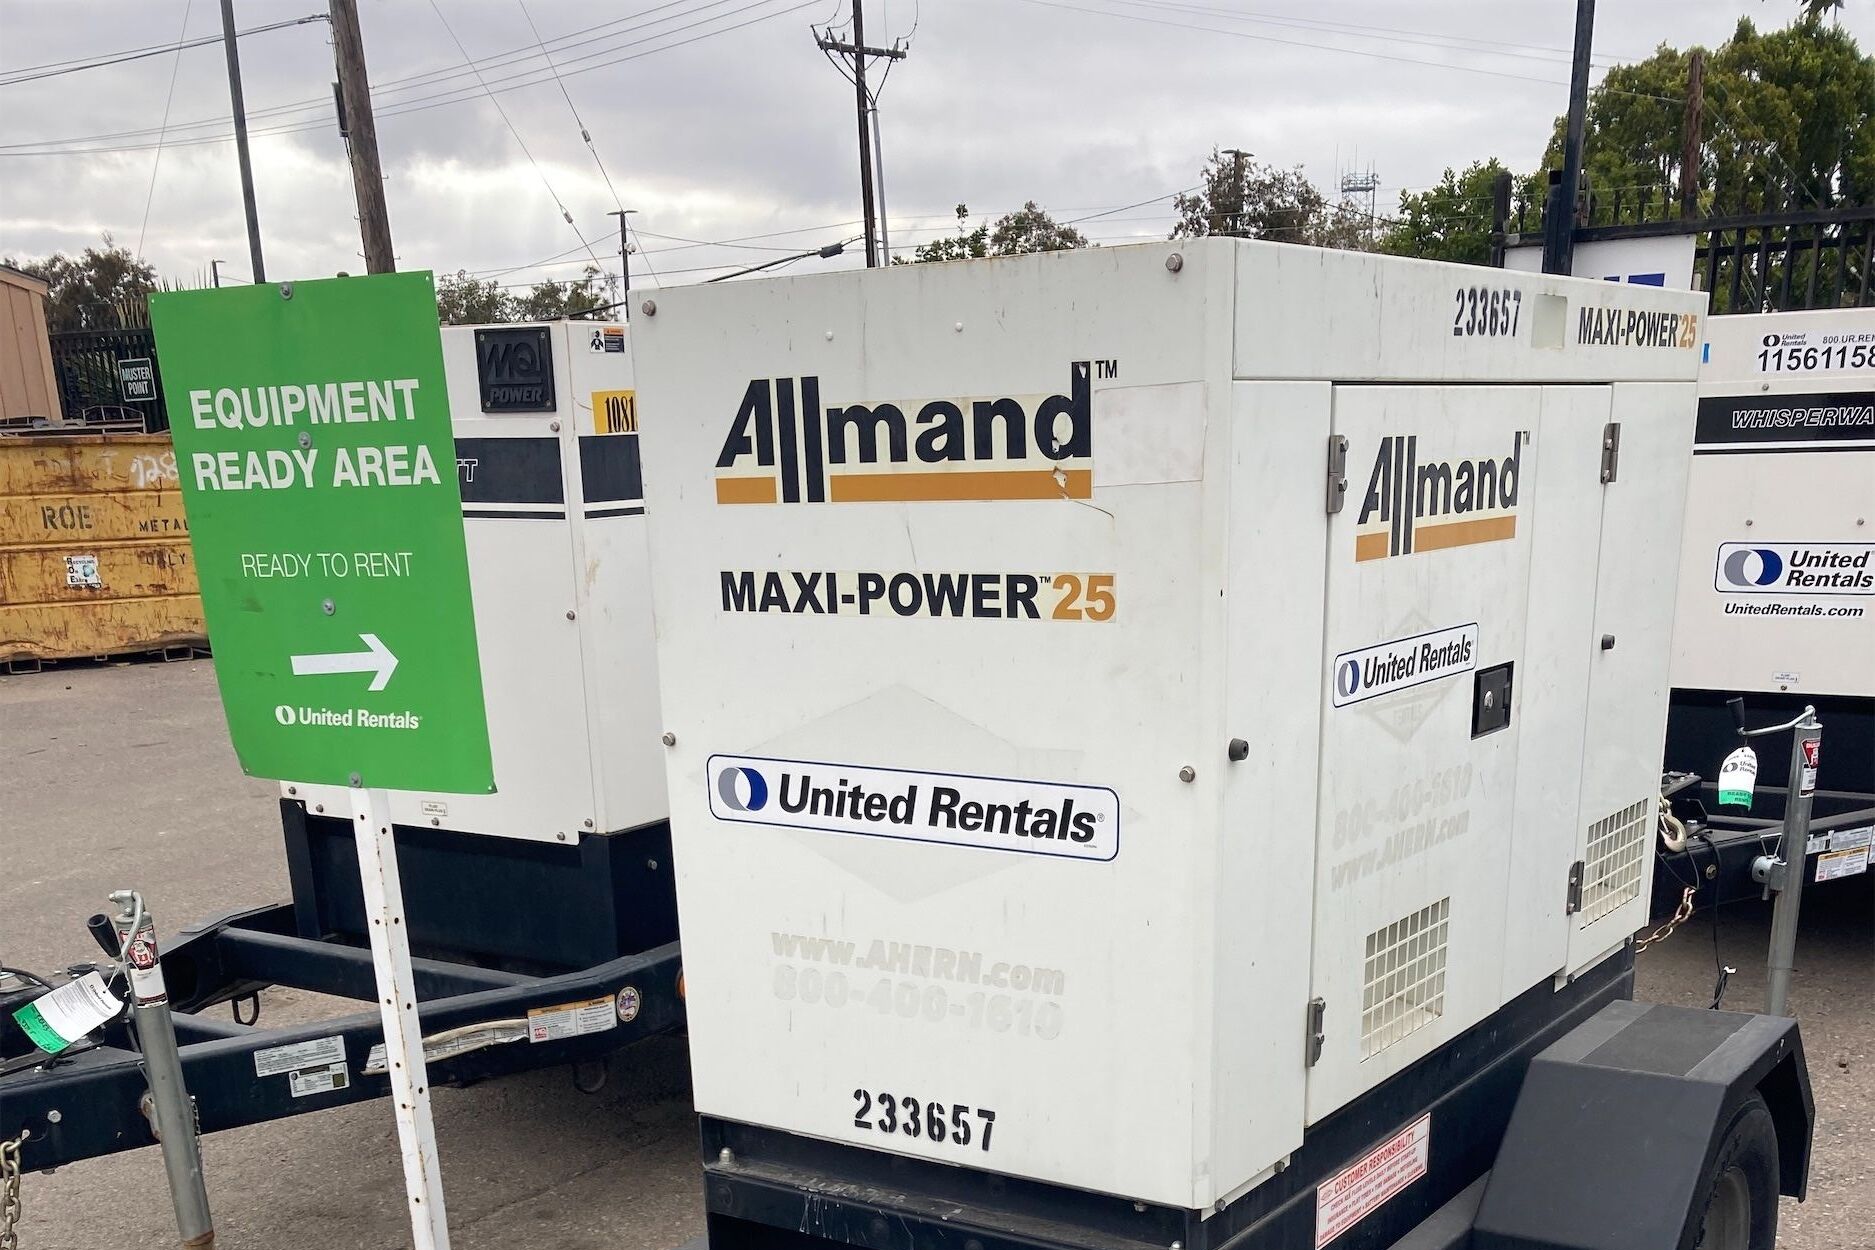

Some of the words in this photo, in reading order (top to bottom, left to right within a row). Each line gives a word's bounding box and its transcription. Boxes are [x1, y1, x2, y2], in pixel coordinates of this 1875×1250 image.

[1453, 287, 1522, 337] 233657
[1578, 306, 1679, 347] MAXI-POWER
[1679, 315, 1697, 349] 25
[1782, 333, 1806, 341] United
[121, 367, 151, 381] MUSTER
[128, 381, 149, 395] POINT
[189, 378, 419, 431] EQUIPMENT
[490, 387, 543, 402] POWER
[605, 396, 638, 433] 1081
[715, 361, 1092, 504] Allmand
[192, 449, 318, 491] READY
[333, 445, 441, 488] AREA
[1357, 431, 1522, 557] Allmand
[41, 505, 93, 530] ROE
[241, 553, 312, 578] READY
[317, 553, 349, 578] TO
[354, 552, 413, 577] RENT
[1786, 570, 1875, 588] Rentals
[1790, 550, 1871, 569] United
[720, 571, 1042, 620] MAXI-POWER
[1051, 574, 1116, 622] 25
[1724, 603, 1864, 617] UnitedRentals.com
[1363, 646, 1417, 689] United
[1419, 634, 1471, 674] Rentals
[299, 706, 352, 727] United
[357, 709, 419, 729] Rentals
[779, 773, 918, 825] United
[928, 786, 1097, 843] Rentals
[853, 1088, 996, 1151] 233657
[1334, 1163, 1367, 1195] CUSTOMER
[1368, 1130, 1414, 1171] RESPONSIBILITY
